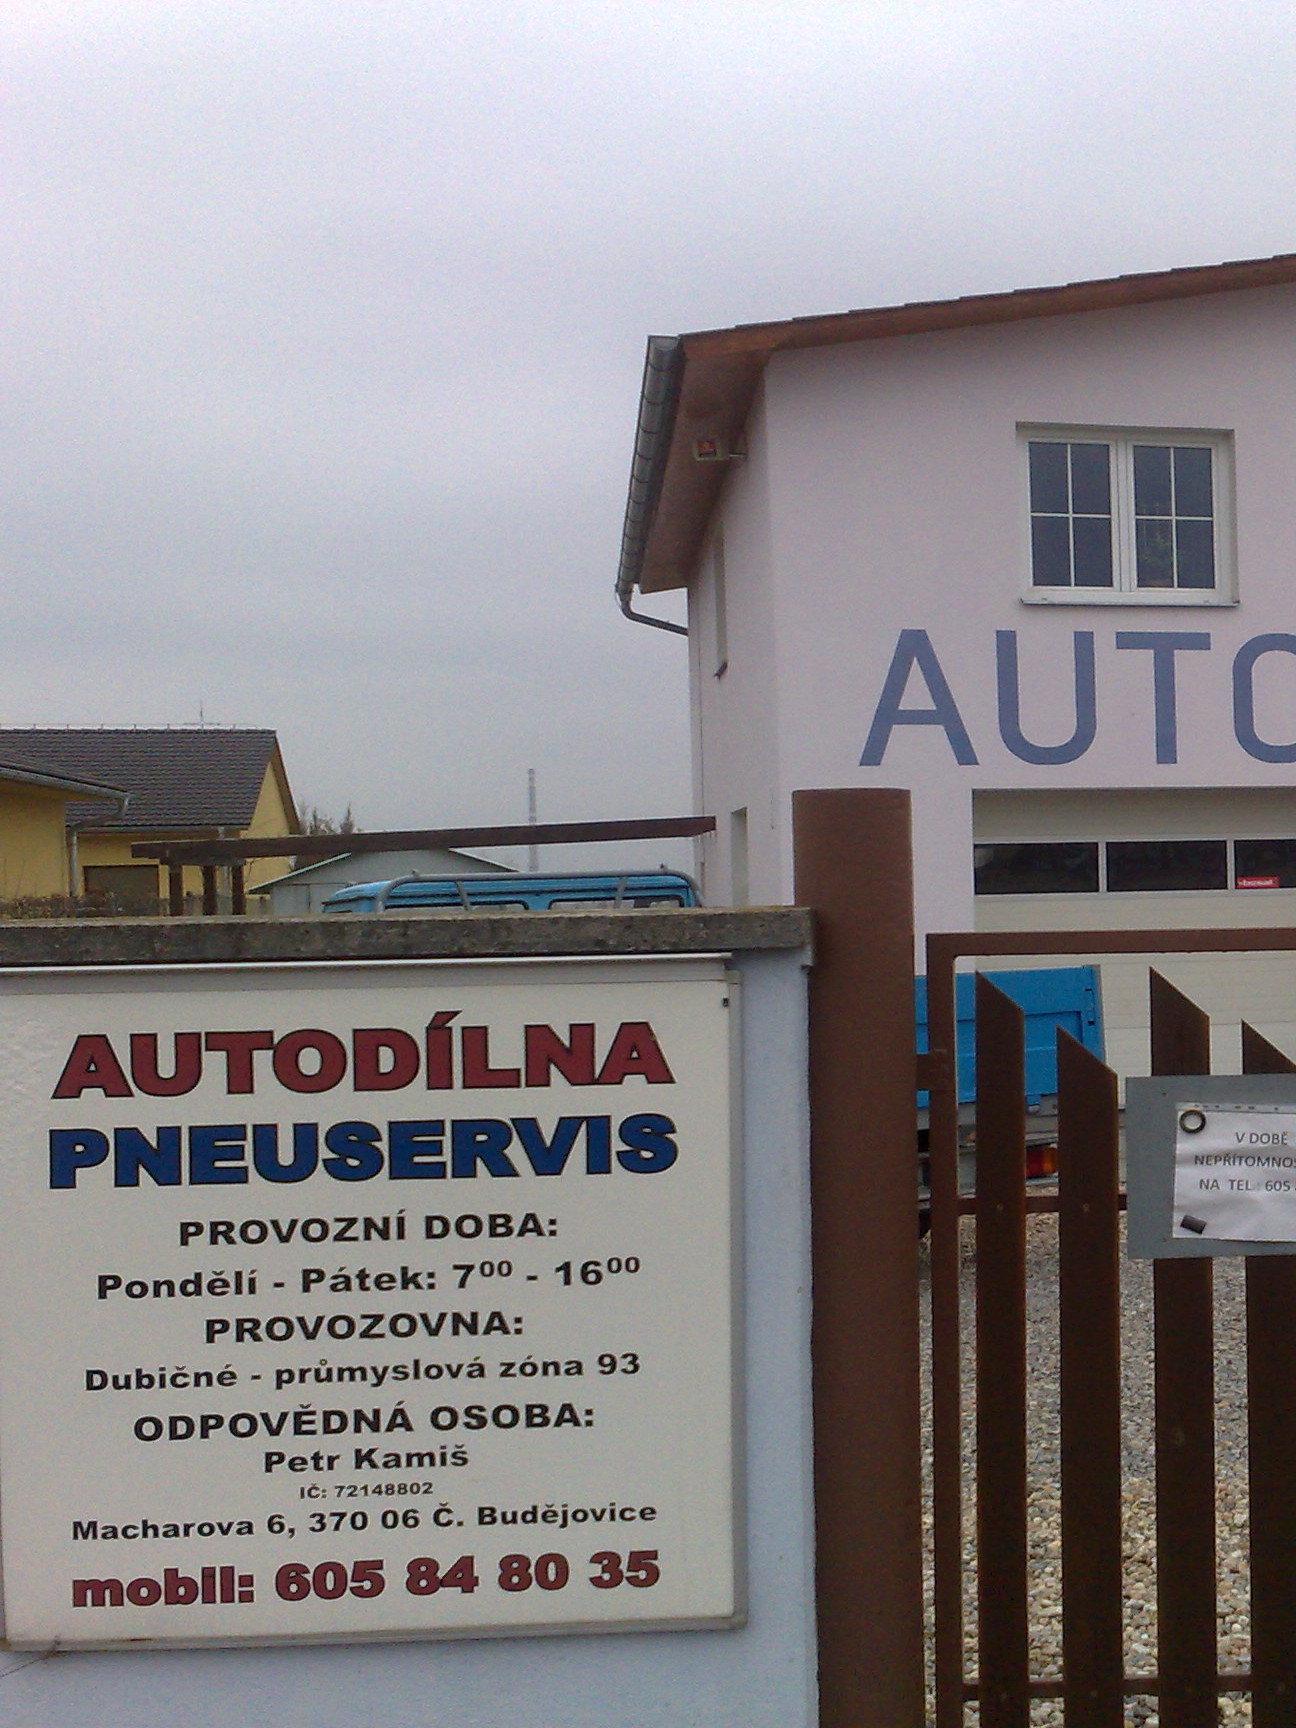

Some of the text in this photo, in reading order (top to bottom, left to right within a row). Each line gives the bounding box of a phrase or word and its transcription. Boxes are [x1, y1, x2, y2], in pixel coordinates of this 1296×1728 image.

[51, 1010, 677, 1100] AUTODÍLNA
[48, 1113, 680, 1190] PNEUSERVIS
[1235, 1131, 1246, 1144] V
[1249, 1131, 1289, 1146] DOBĚ
[1199, 1178, 1220, 1191] NA
[1264, 1179, 1291, 1192] 605
[179, 1208, 558, 1247] PROVOZNÍ DOBA:
[97, 1269, 258, 1300] Pondělí
[301, 1266, 437, 1293] Pátek:
[204, 1311, 524, 1345] PROVOZOVNA:
[85, 1364, 238, 1392] Dubičné
[275, 1356, 486, 1391] průmyslová
[499, 1355, 585, 1380] zóna
[597, 1353, 641, 1376] 93
[133, 1400, 594, 1443] ODPOVĚDNÁ OSOBA:
[264, 1444, 470, 1474] Petr Kamiš
[299, 1481, 434, 1500] IČ: 72148802
[72, 1502, 658, 1541] Macharova 6, 370 06 Č. Budějovice
[72, 1549, 661, 1608] mobil: 605 84 80 35
